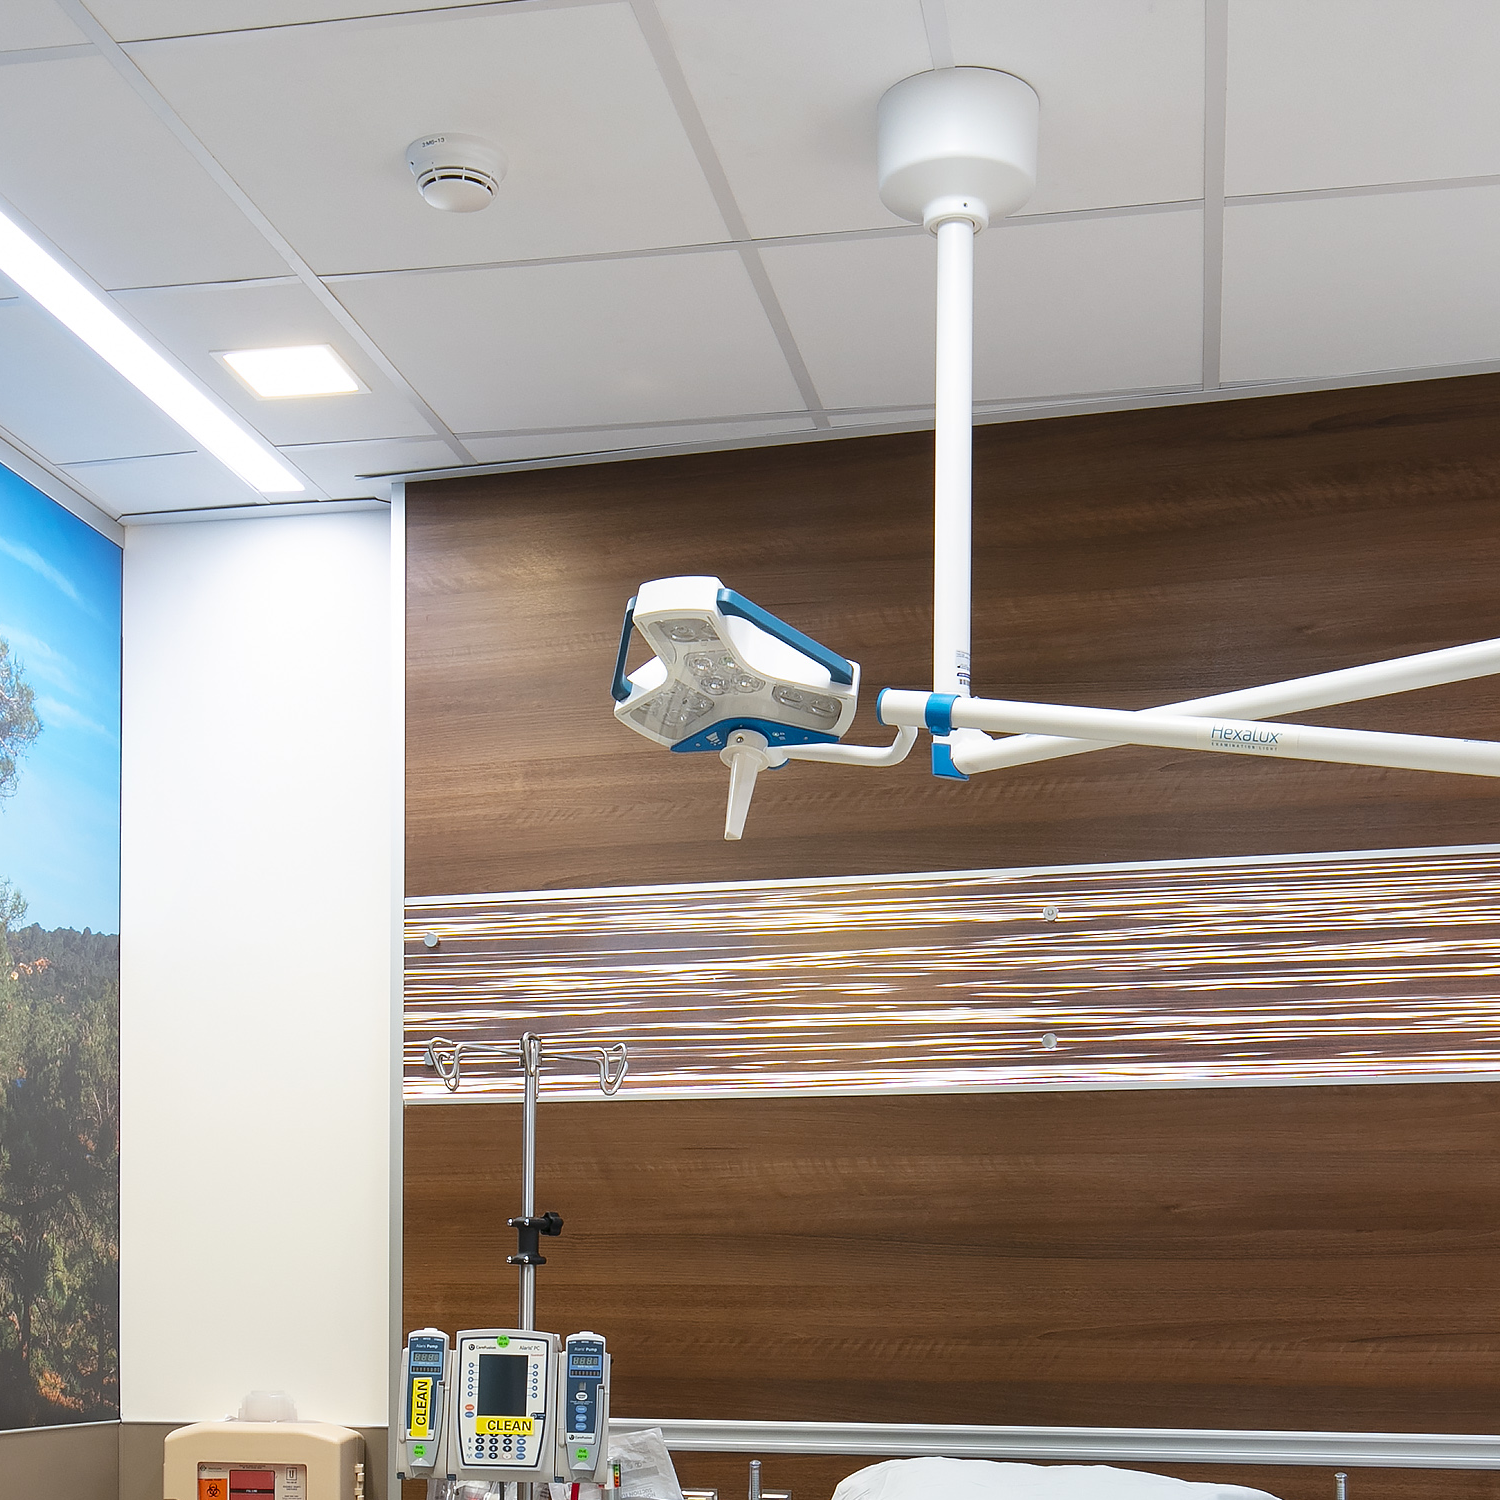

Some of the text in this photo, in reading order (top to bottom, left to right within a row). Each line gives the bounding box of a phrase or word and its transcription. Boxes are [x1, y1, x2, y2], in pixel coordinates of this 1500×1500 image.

[1212, 742, 1256, 750] EXAMINATION
[416, 1381, 428, 1425] CLEAN
[488, 1420, 532, 1431] CLEAN
